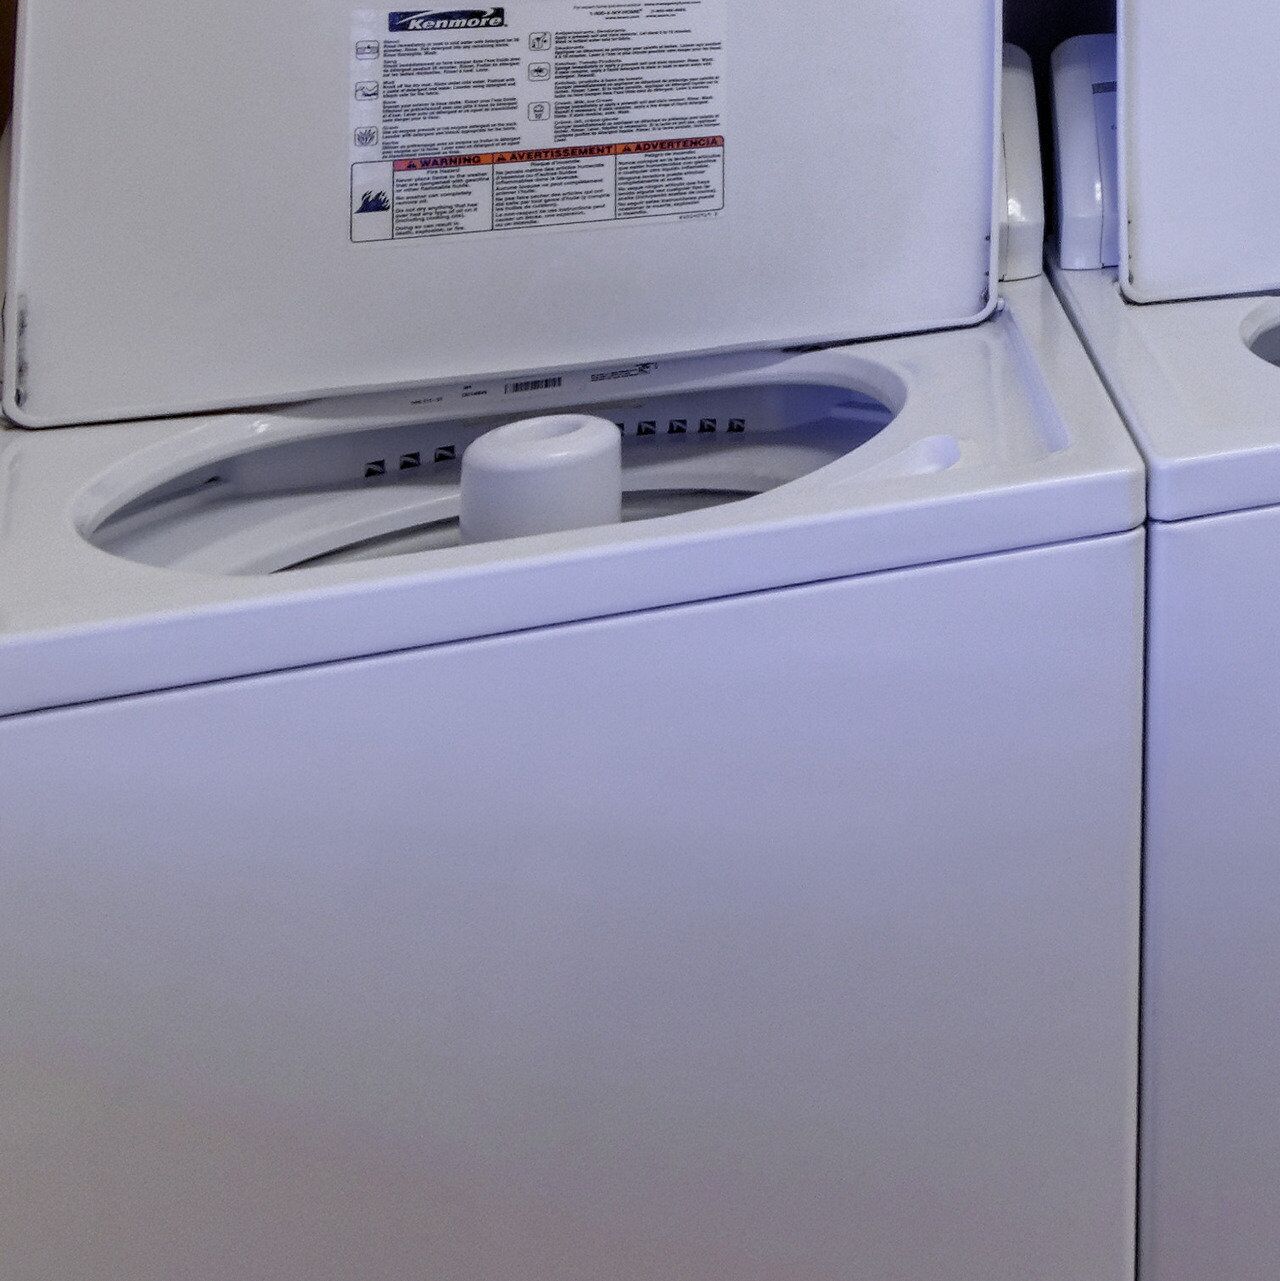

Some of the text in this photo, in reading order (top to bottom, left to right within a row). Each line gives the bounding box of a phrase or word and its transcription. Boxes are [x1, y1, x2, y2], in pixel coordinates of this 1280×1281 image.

[407, 17, 503, 30] Kenmore
[509, 145, 613, 160] AVERTISSEMENT
[420, 156, 480, 167] WARNING
